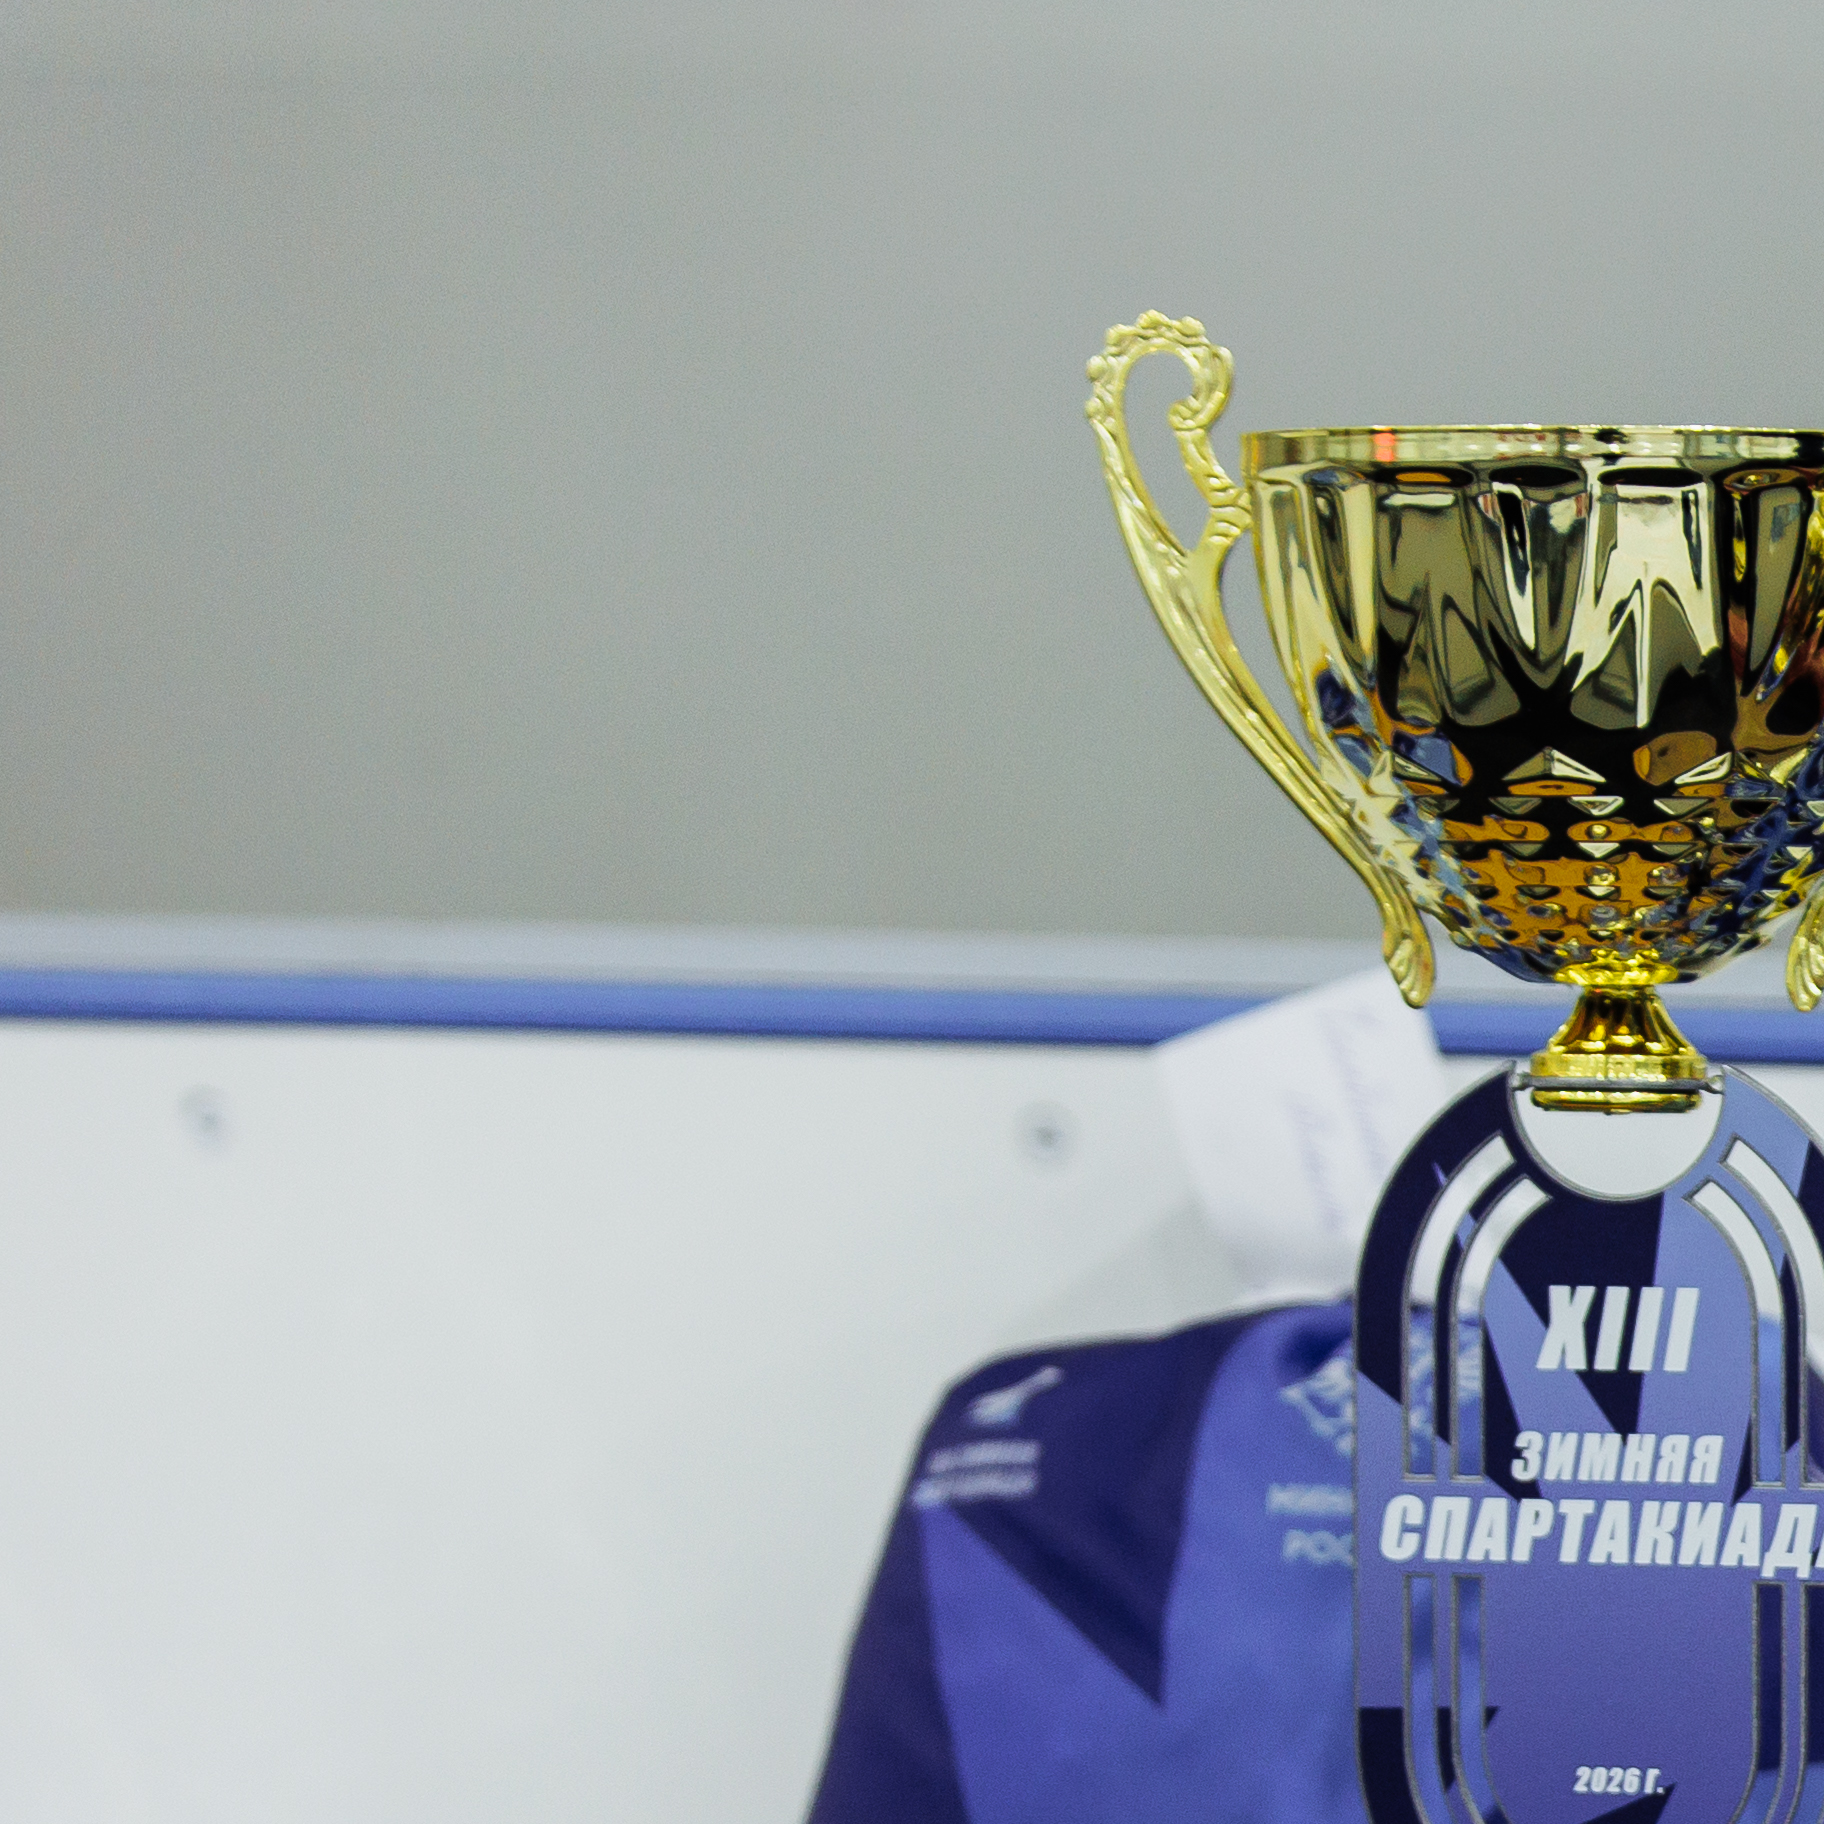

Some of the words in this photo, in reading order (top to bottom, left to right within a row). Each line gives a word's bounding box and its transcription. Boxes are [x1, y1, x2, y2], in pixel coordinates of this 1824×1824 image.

[1536, 1285, 1700, 1372] XIII
[1511, 1431, 1724, 1484] ЗИМНЯЯ
[1573, 1766, 1641, 1793] 2026
